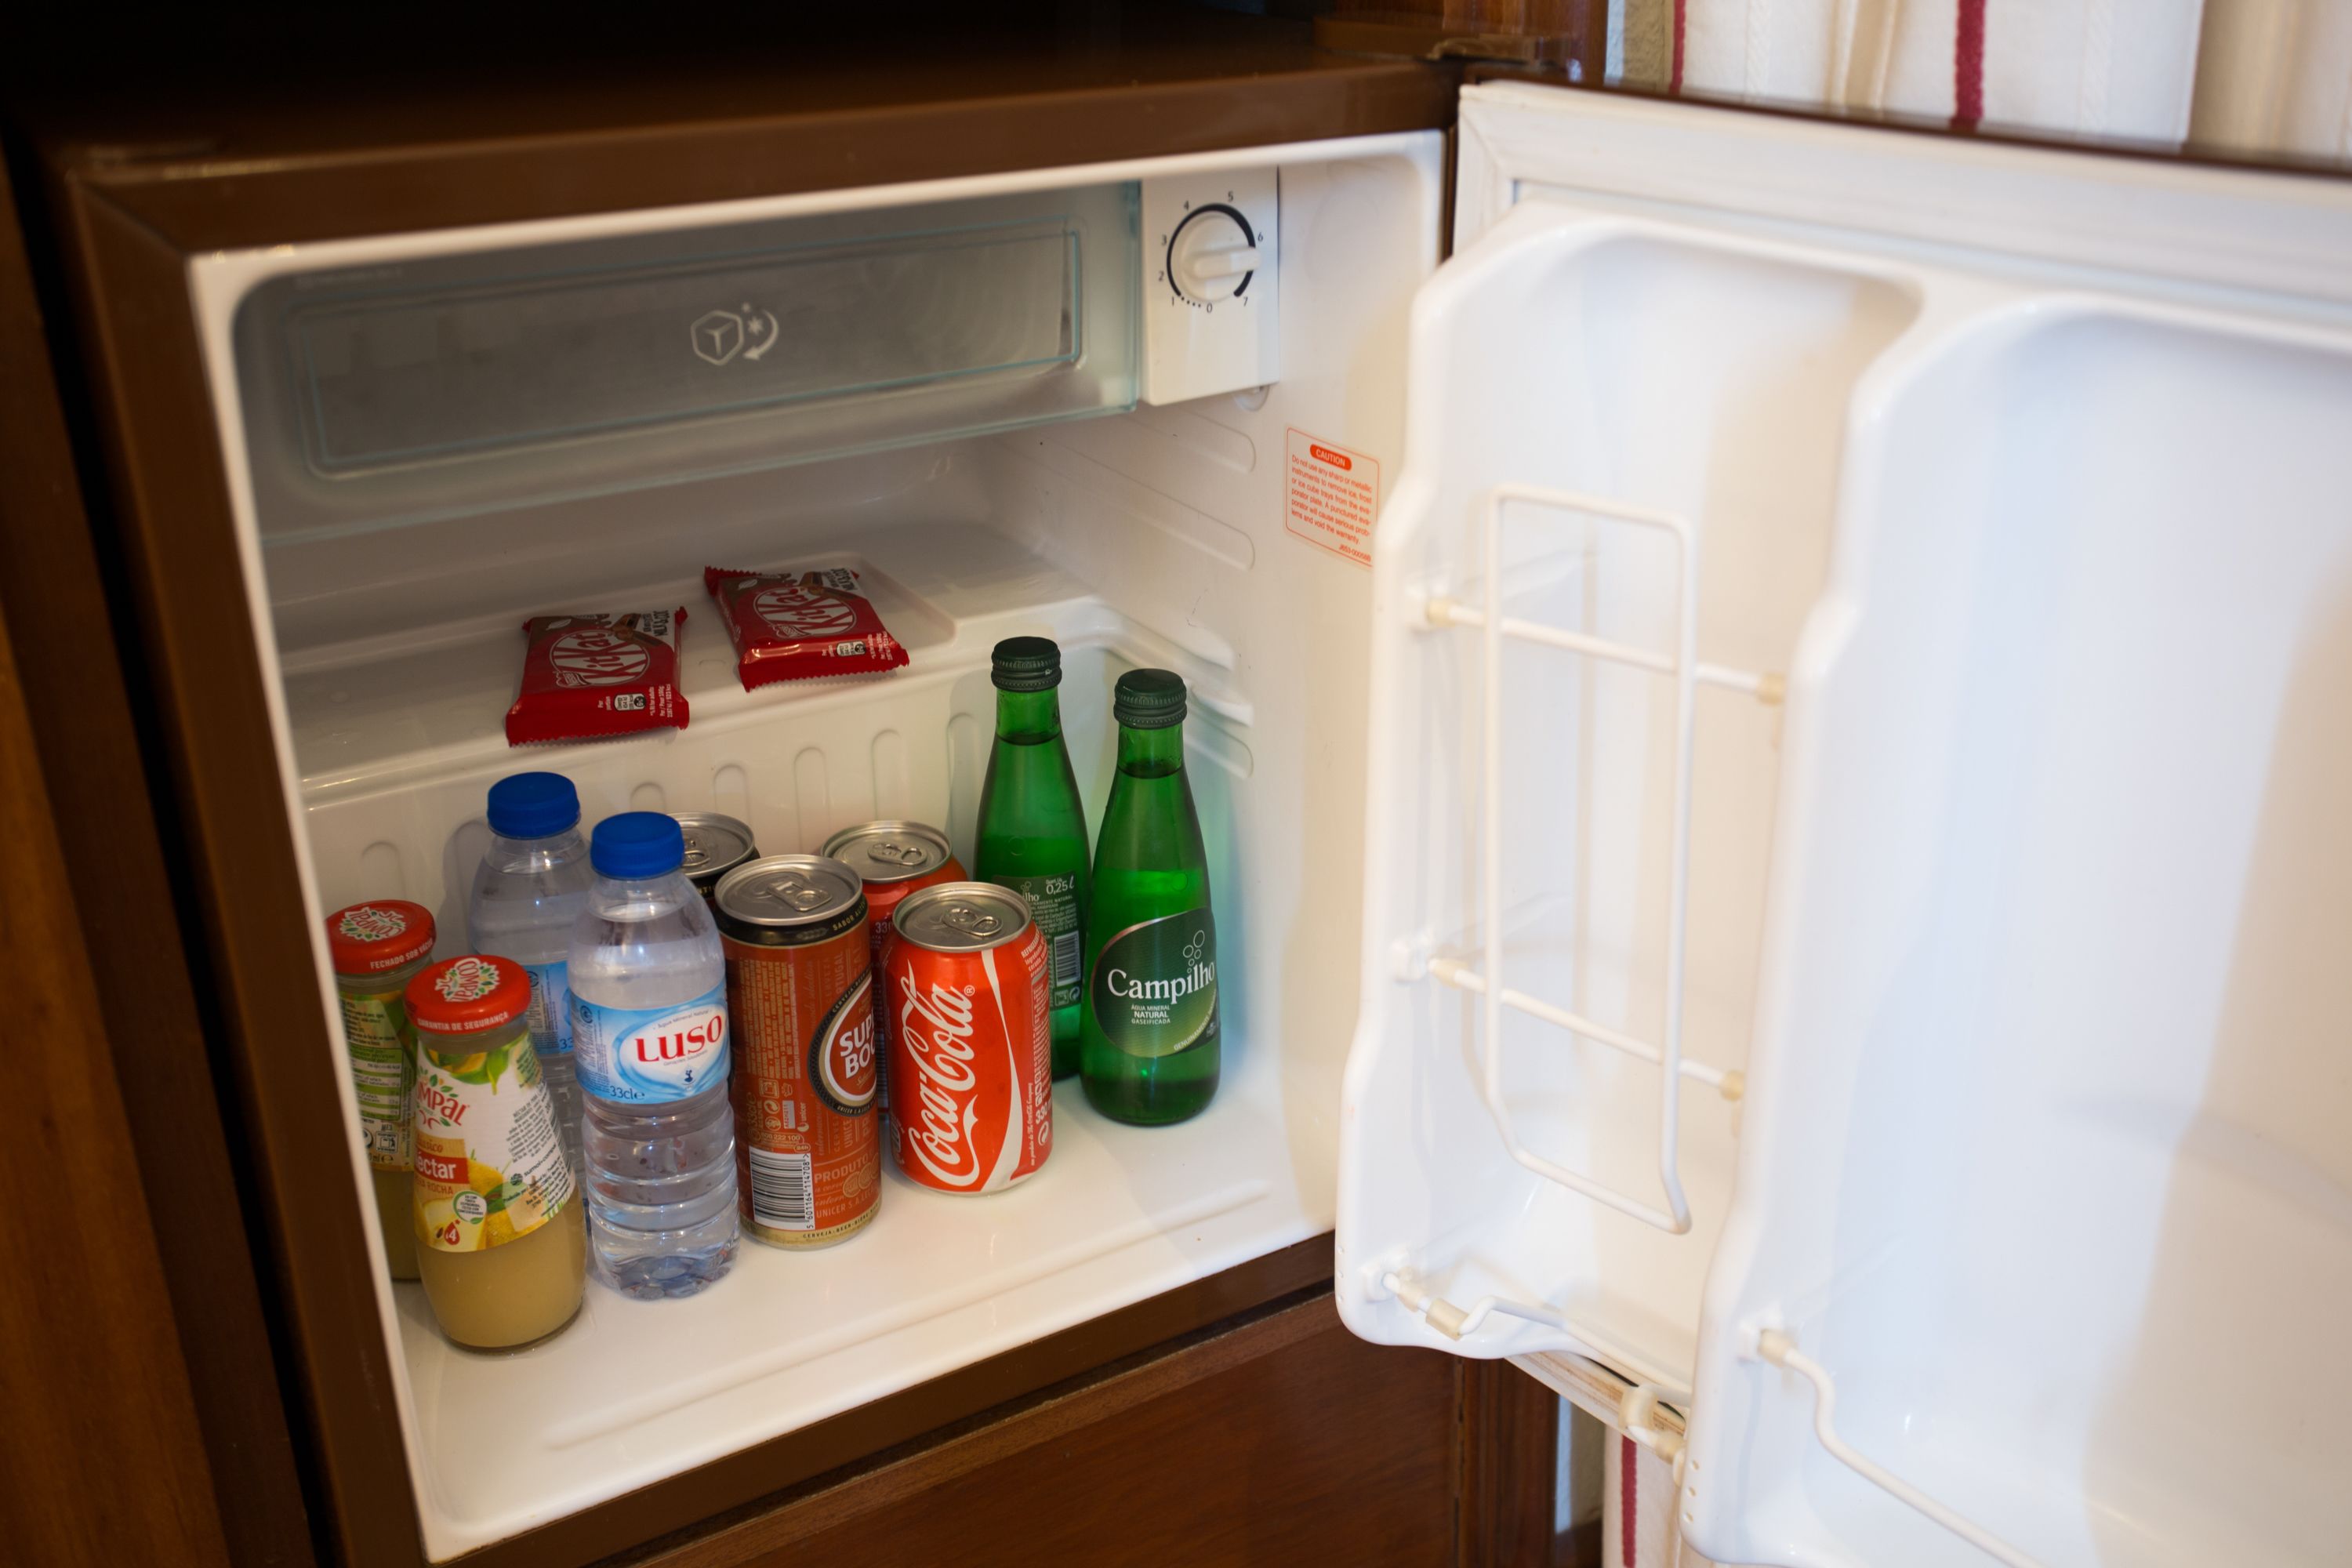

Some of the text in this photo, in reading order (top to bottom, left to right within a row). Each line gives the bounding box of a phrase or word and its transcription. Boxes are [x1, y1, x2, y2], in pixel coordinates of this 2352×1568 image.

[1183, 200, 1190, 211] 4
[1228, 191, 1234, 202] 5
[1161, 234, 1167, 246] 3
[1258, 231, 1264, 242] 6
[1158, 270, 1164, 281] 2
[1206, 303, 1213, 314] 0
[1243, 296, 1249, 307] 7
[1316, 448, 1346, 467] CAUTION
[1292, 454, 1300, 464] Do
[1308, 462, 1318, 471] use
[1318, 466, 1328, 477] any
[1329, 469, 1344, 483] sharp
[1344, 476, 1351, 485] or
[1351, 477, 1372, 492] metallic
[1292, 466, 1319, 484] instruments
[1321, 477, 1327, 486] to
[1327, 481, 1347, 495] remove
[1359, 492, 1372, 504] frost
[1292, 488, 1308, 501] porator
[1325, 500, 1330, 509] A
[1330, 504, 1358, 521] punctured
[1307, 484, 1319, 494] cube
[1320, 488, 1334, 501] trays
[1335, 494, 1348, 506] from
[1348, 499, 1358, 510] the
[1292, 499, 1308, 511] porator
[1309, 505, 1318, 514] will
[1318, 510, 1334, 522] cause
[1335, 515, 1355, 532] serious
[1304, 514, 1313, 524] and
[1314, 517, 1325, 530] void
[1326, 523, 1335, 534] the
[552, 633, 647, 680] KitKat
[1046, 880, 1068, 895] 0,25
[833, 915, 855, 931] SABOR
[370, 955, 405, 970] FECHADO
[405, 948, 419, 960] SOB
[1107, 961, 1216, 1005] Campilho
[417, 1010, 509, 1031] GARANTIA DE SEGURANÇA
[634, 1015, 723, 1062] LUSO
[1173, 1016, 1210, 1052] GENUINAMENTE
[900, 960, 980, 1186] Coca-Cola
[1036, 1102, 1048, 1125] 330
[815, 1153, 869, 1183] PRODUTO
[426, 1181, 454, 1195] ROCHA
[815, 1202, 846, 1218] UNICER
[803, 1229, 833, 1239] CERVEJA
[836, 1223, 851, 1233] BEER
